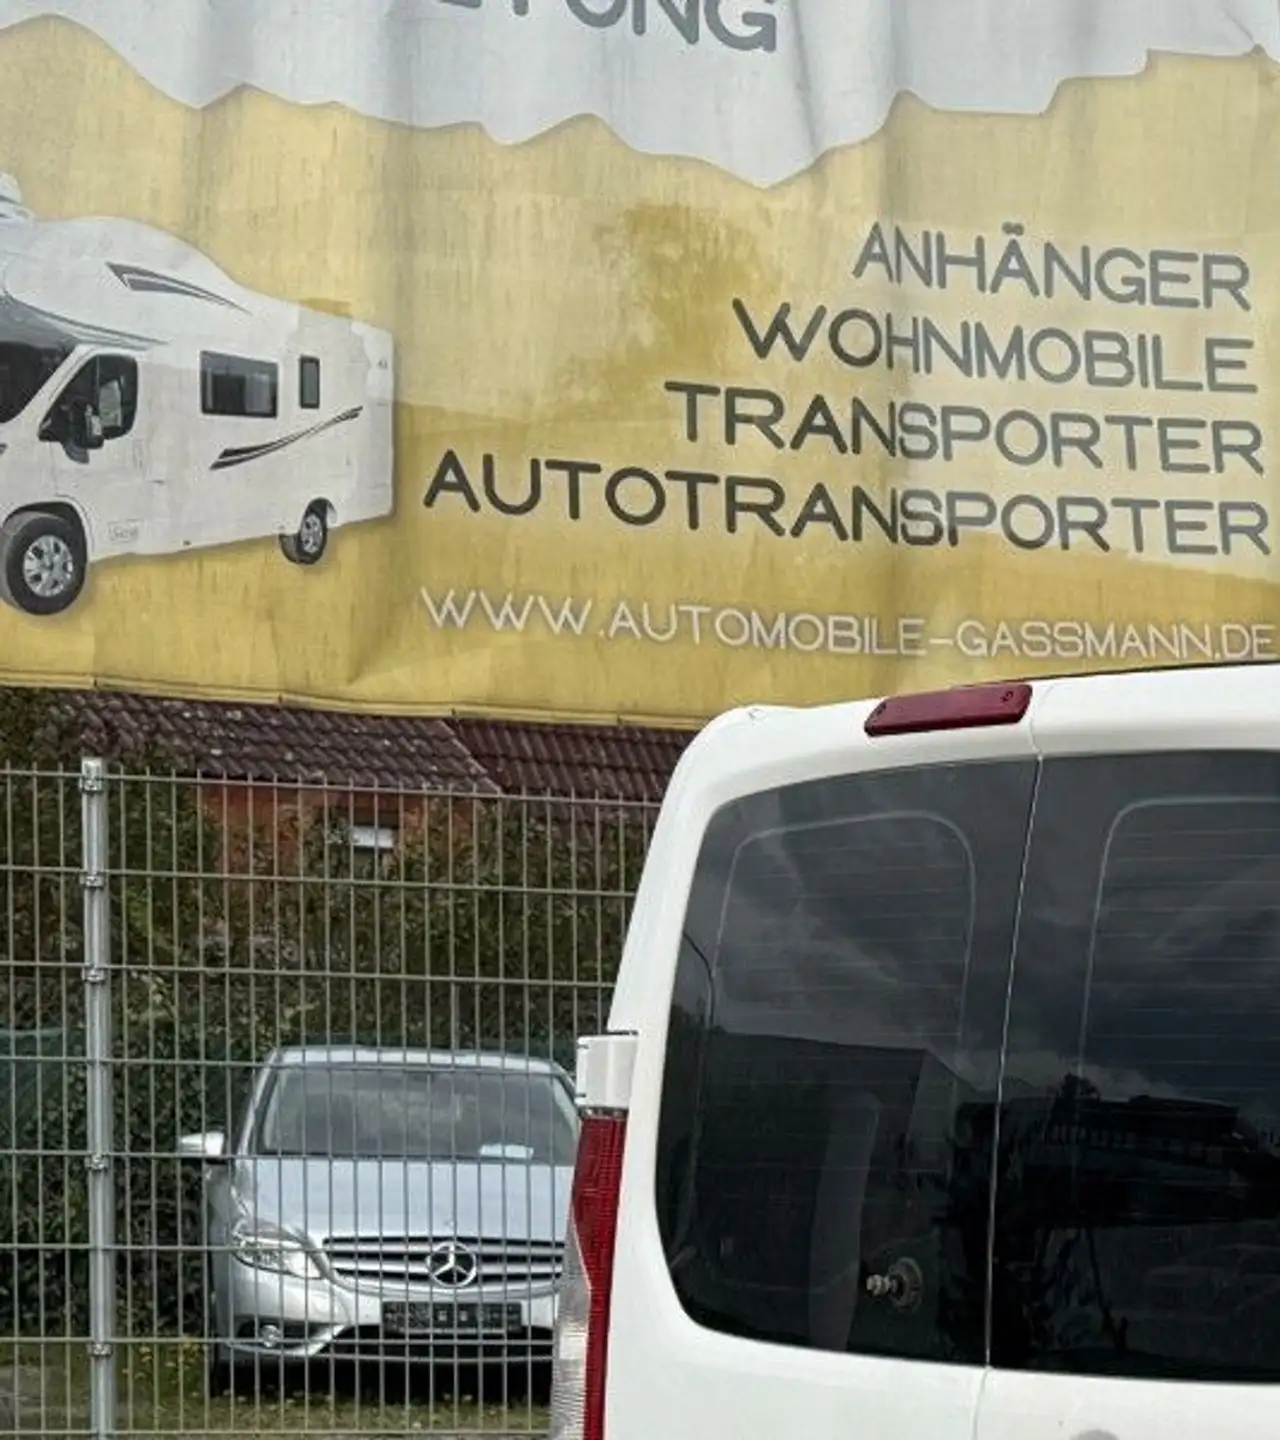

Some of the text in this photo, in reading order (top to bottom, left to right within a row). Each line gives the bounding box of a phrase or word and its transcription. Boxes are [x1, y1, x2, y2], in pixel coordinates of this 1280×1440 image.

[852, 222, 1252, 312] ANHÄNGER
[731, 298, 1258, 393] WOHNMOBILE
[664, 380, 1266, 475] TRANSPORTER
[423, 450, 1270, 556] AUTOTRANSPORTER
[420, 588, 1278, 660] WWW.AUTOMOBILE-GASSMANN.DE
